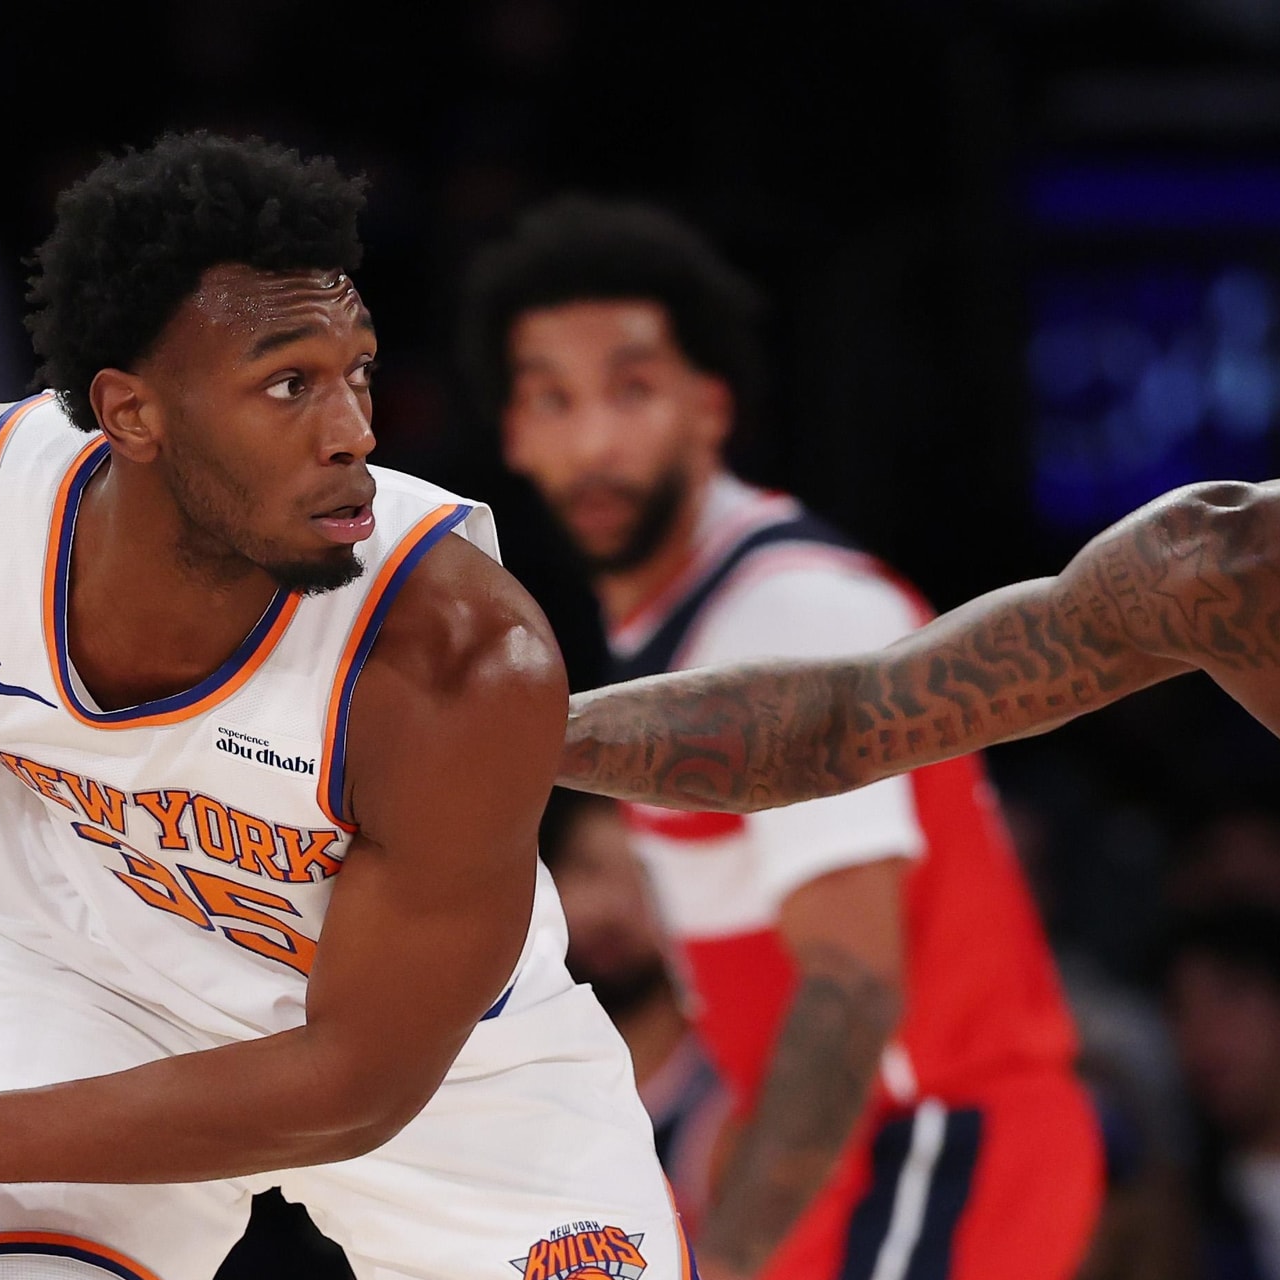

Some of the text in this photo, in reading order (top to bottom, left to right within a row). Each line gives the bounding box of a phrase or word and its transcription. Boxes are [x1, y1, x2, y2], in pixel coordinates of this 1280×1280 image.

[218, 726, 270, 747] experience
[216, 738, 252, 760] abu
[133, 789, 344, 884] YORK
[70, 821, 318, 978] 35
[550, 1220, 601, 1241] NEW YORK
